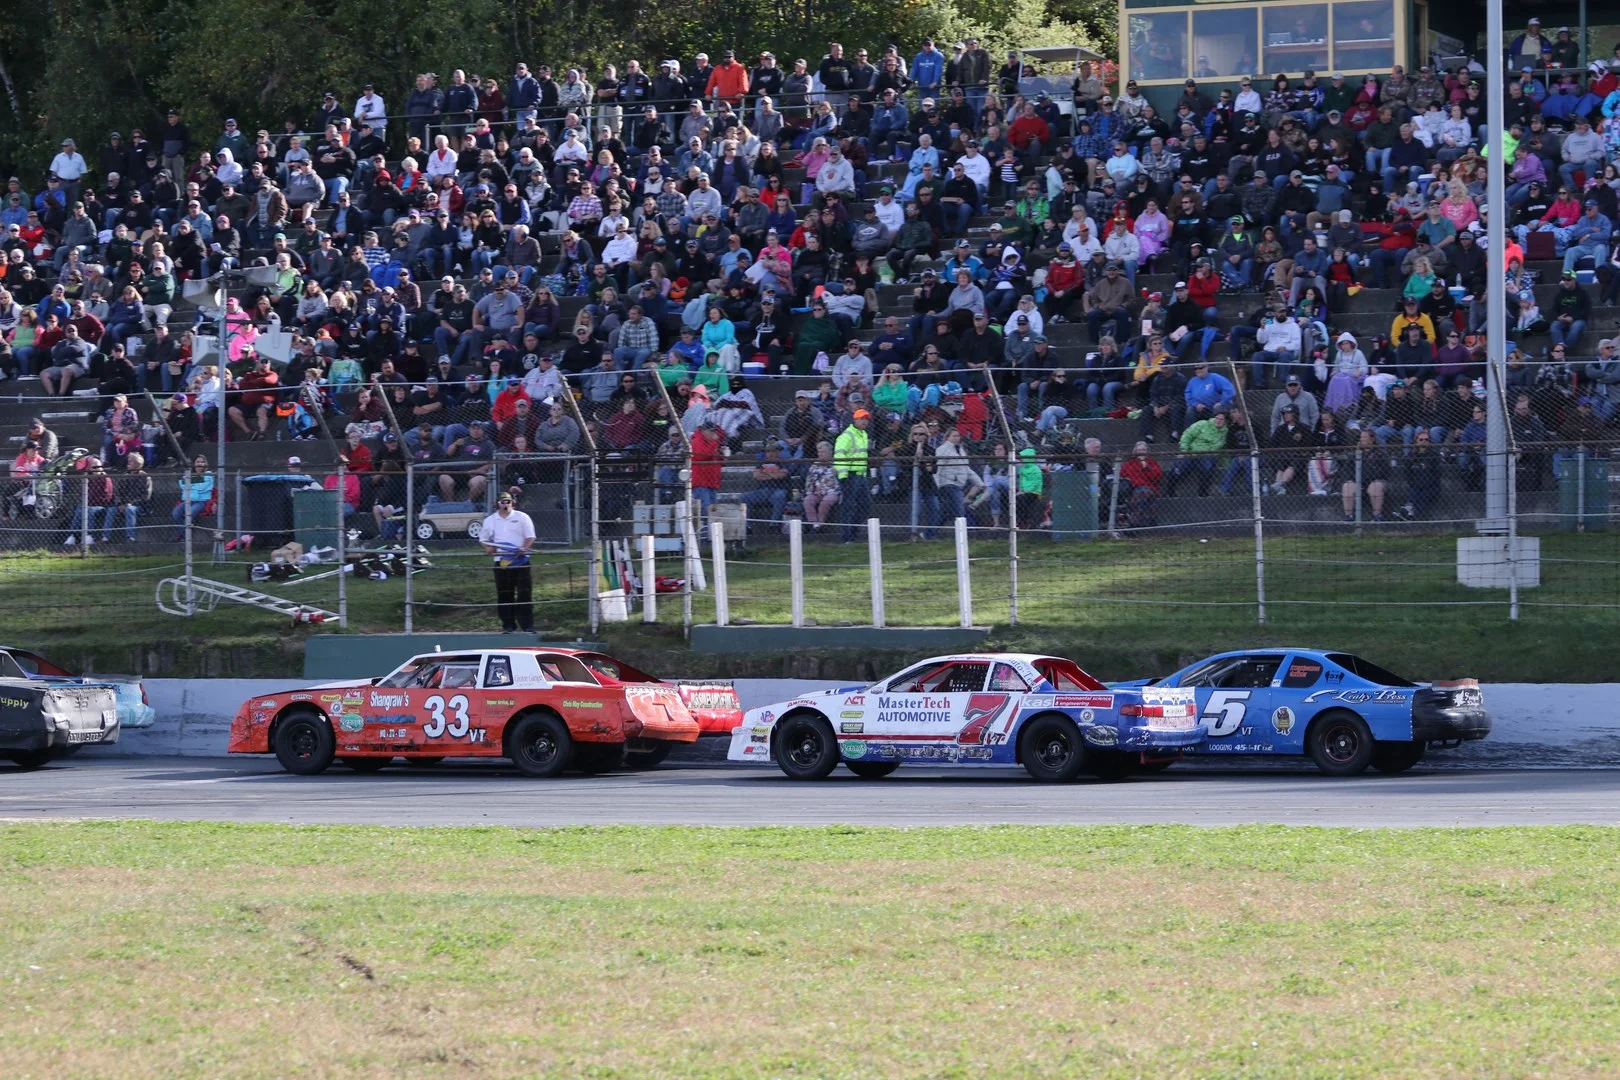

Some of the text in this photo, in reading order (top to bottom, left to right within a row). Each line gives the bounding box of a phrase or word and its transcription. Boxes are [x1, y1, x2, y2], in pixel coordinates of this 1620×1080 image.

[0, 697, 29, 709] upply
[844, 696, 866, 706] ACT
[878, 697, 951, 709] MasterTech
[1020, 694, 1053, 706] kas
[423, 694, 486, 742] 33 VT
[877, 711, 951, 722] AUTOMOTIVE
[958, 693, 1010, 745] 7
[1198, 690, 1254, 738] 5 VT
